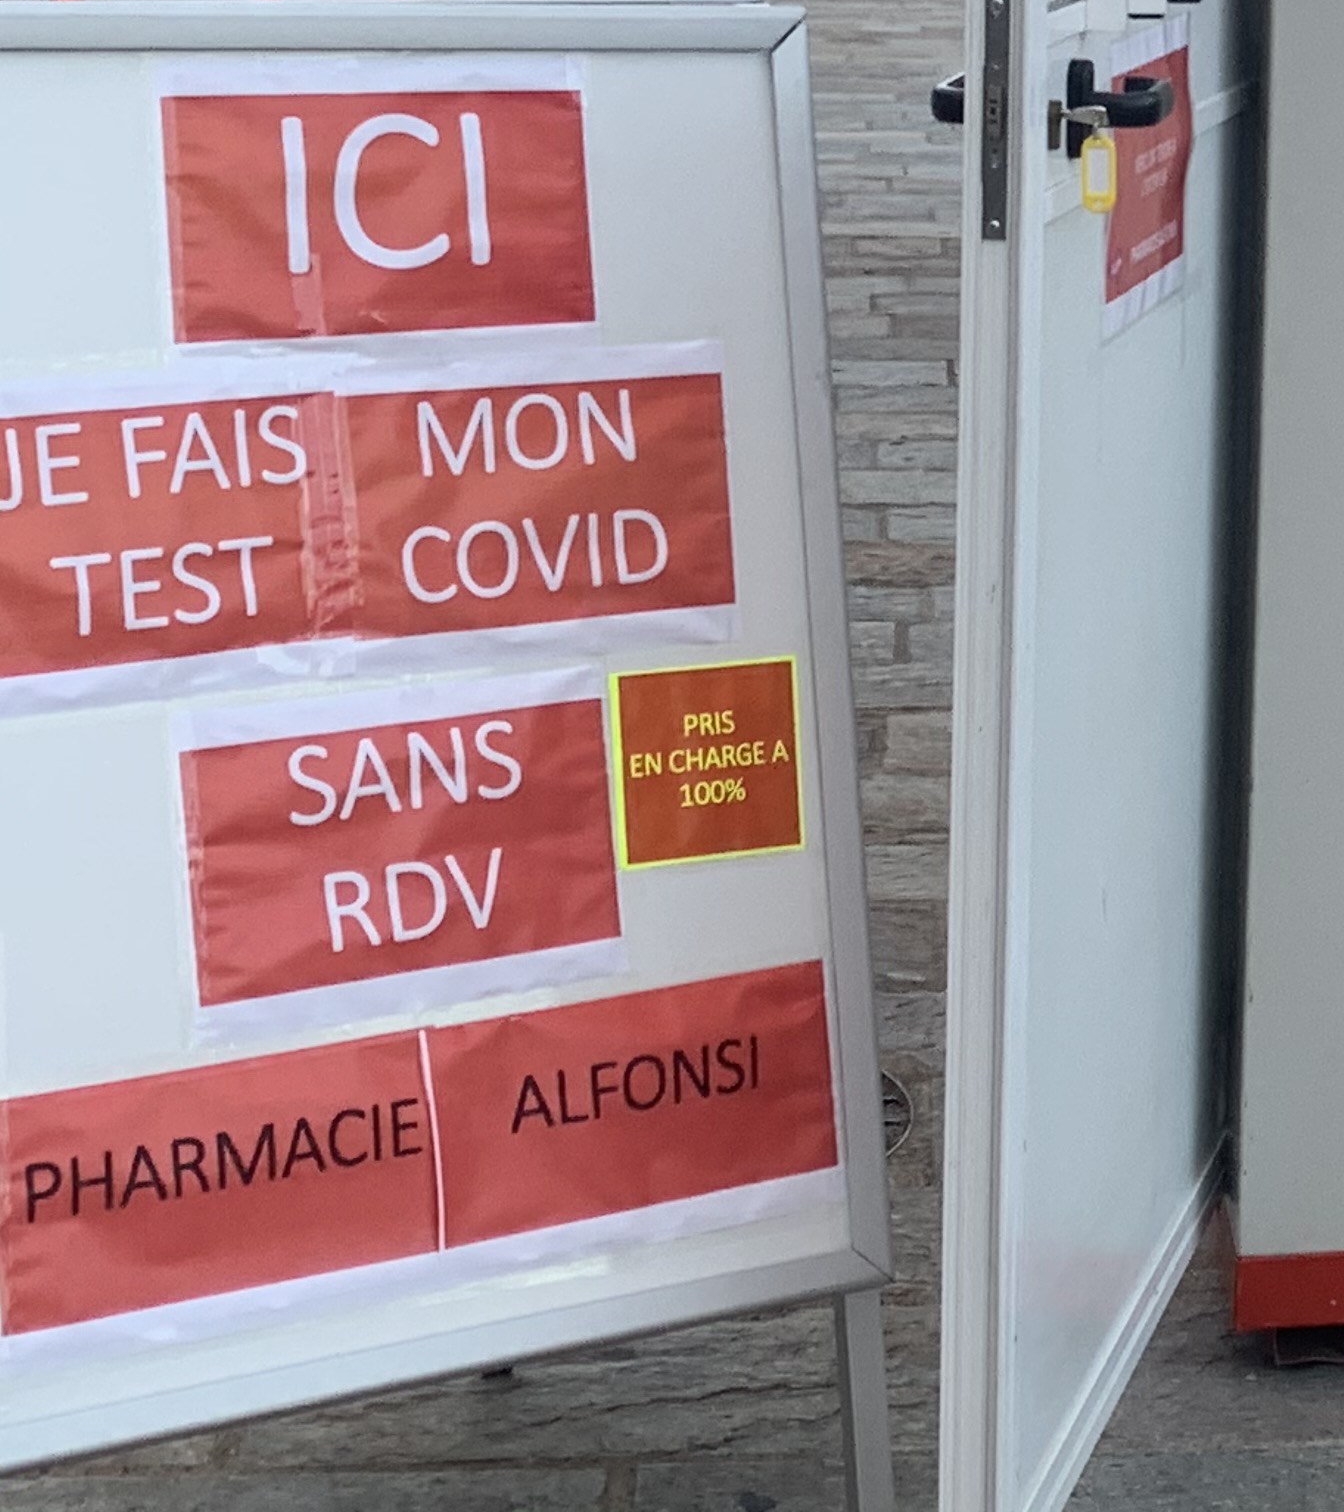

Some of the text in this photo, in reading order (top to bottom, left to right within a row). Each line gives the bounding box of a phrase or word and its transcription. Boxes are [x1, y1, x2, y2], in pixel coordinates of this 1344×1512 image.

[280, 111, 493, 276] ICI
[0, 387, 638, 512] JE FAIS MON
[49, 507, 671, 638] TEST COVID
[288, 719, 524, 828] SANS
[629, 739, 790, 779] EN CHARGE A
[683, 710, 736, 737] PRIS
[679, 777, 747, 808] 100%
[322, 846, 503, 954] RDV
[22, 1034, 760, 1225] PHARMACIE ALFONSI
